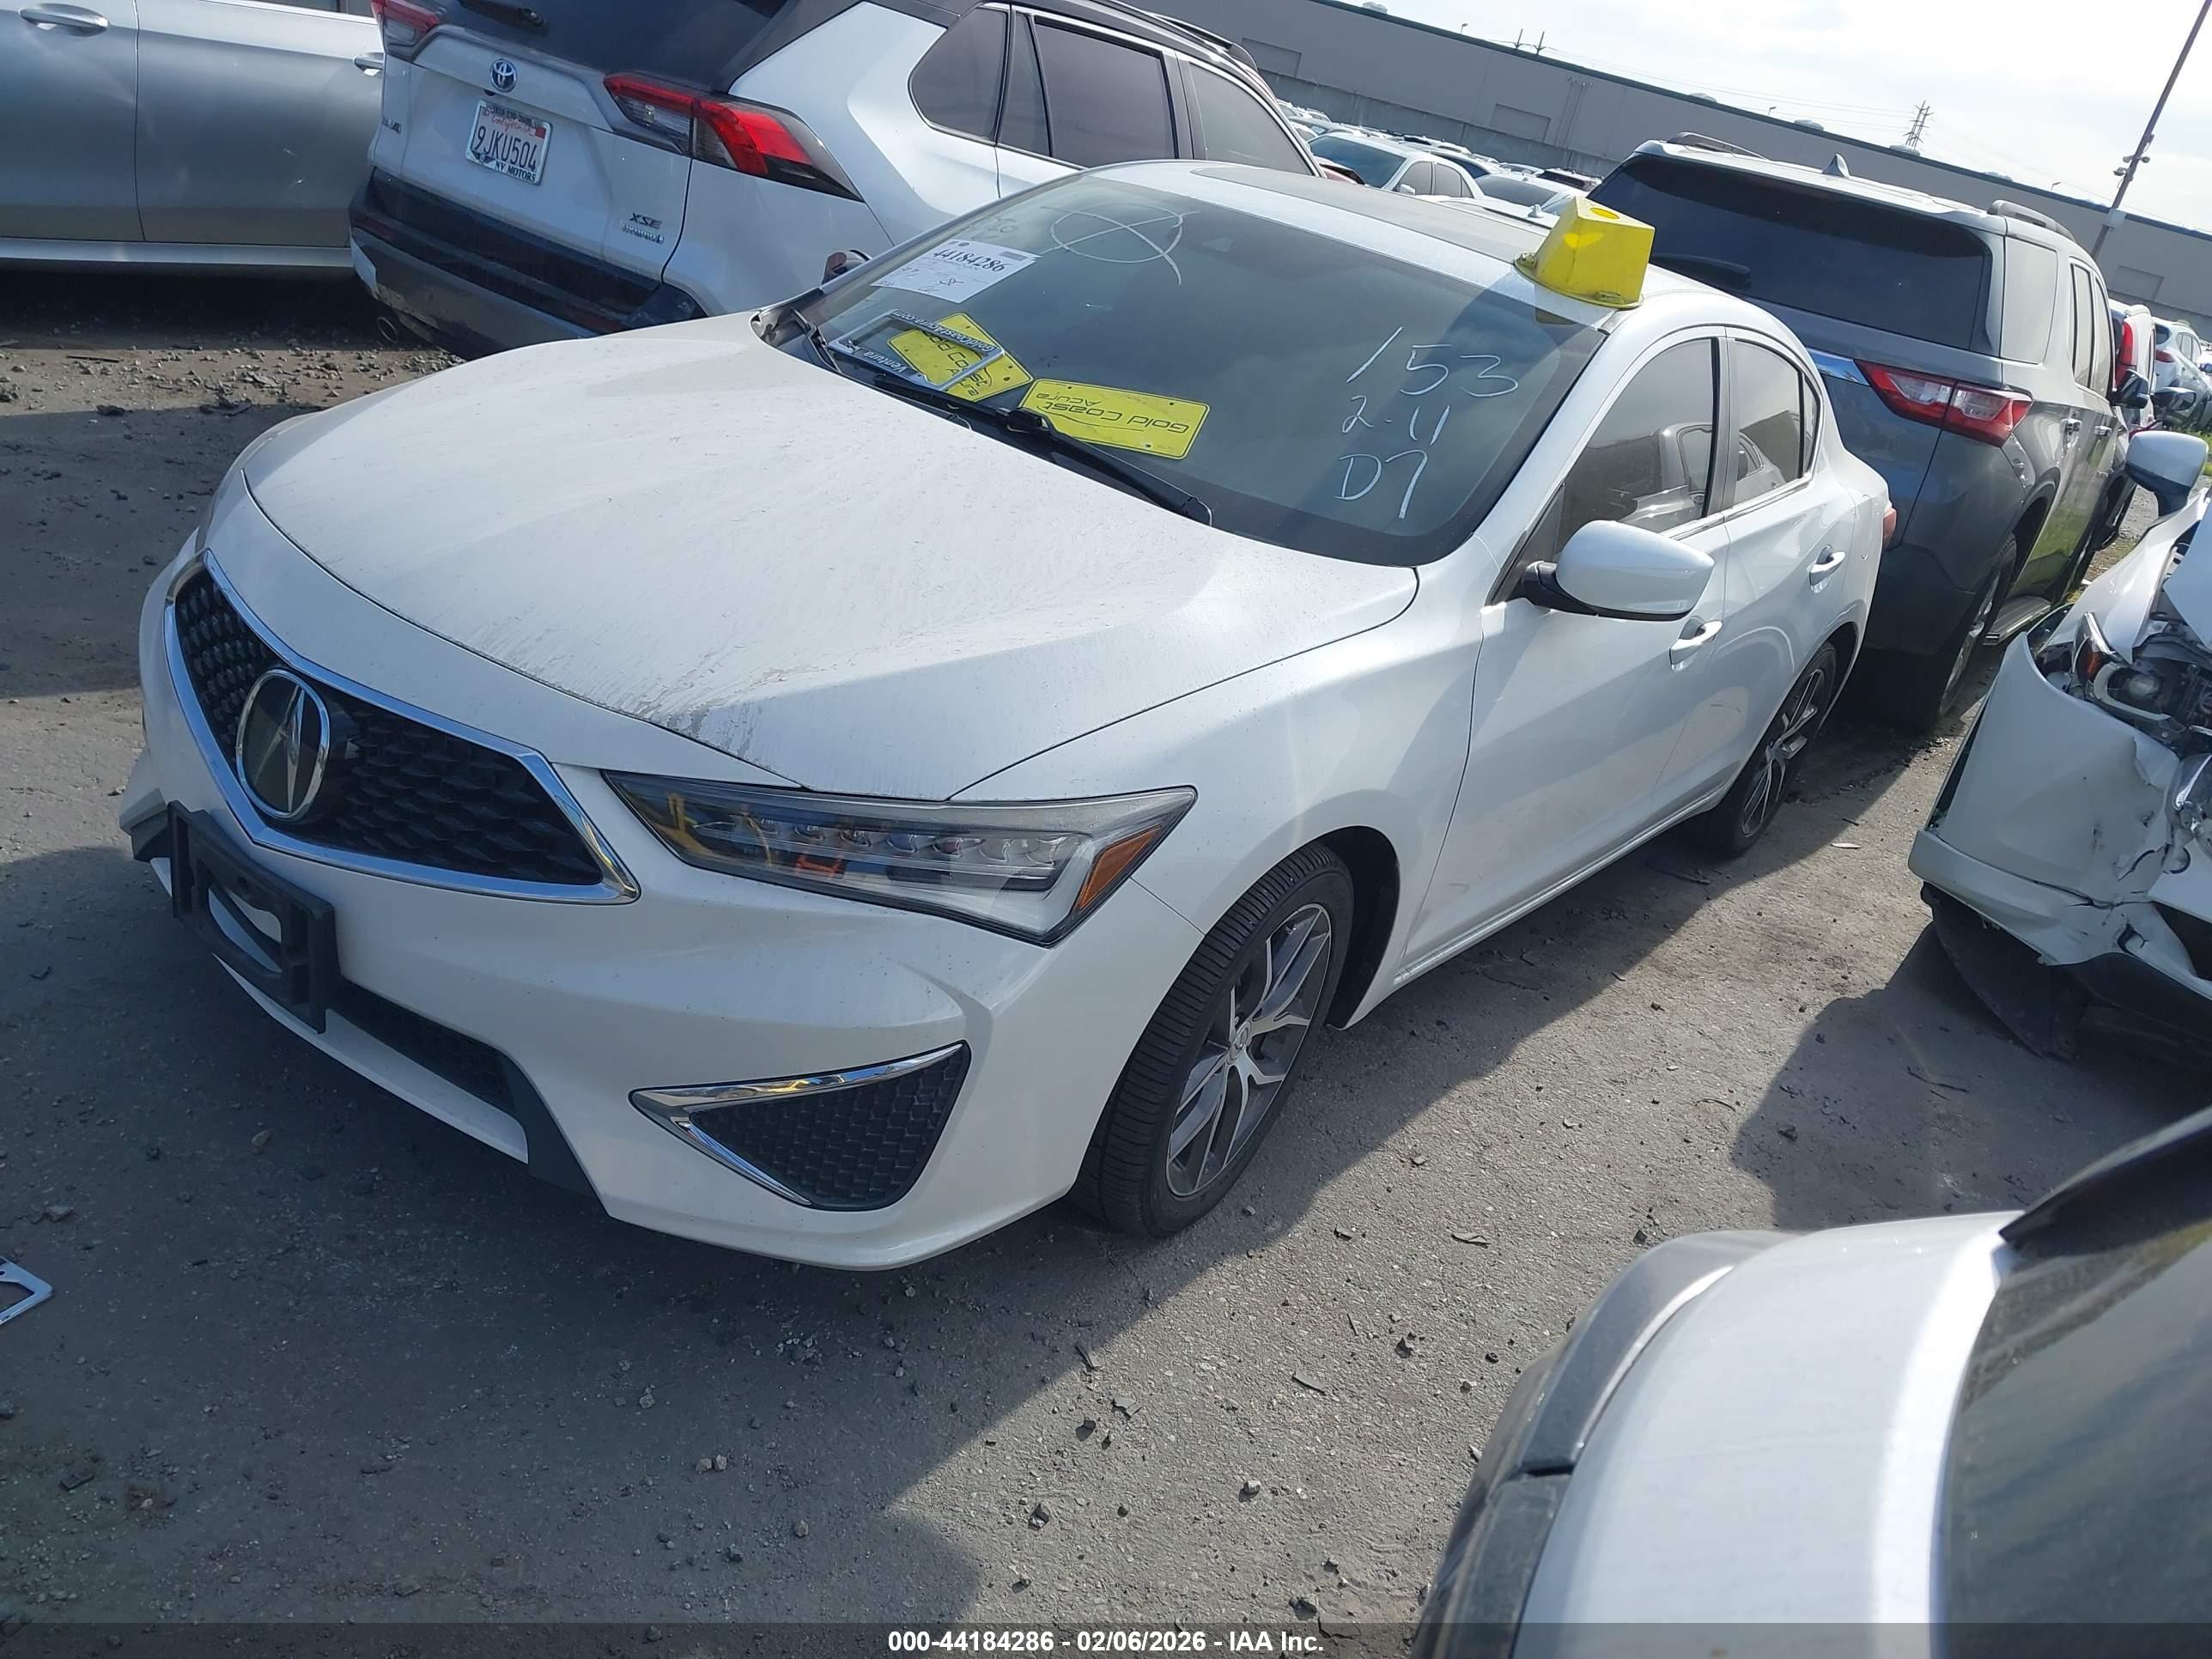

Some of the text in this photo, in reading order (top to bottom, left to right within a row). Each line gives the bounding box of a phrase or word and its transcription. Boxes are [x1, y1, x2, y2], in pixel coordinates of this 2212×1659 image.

[474, 125, 538, 172] 9JKU504
[495, 161, 537, 183] NV MOTORS
[629, 212, 662, 230] XSE
[933, 248, 1010, 272] 44184286
[892, 309, 995, 353] GoldCoastAcura.com
[863, 350, 908, 374] Ventura
[947, 351, 988, 386] Cost
[945, 368, 979, 396] Aura
[1036, 392, 1102, 407] Acura
[1043, 401, 1189, 434] Gold Coast
